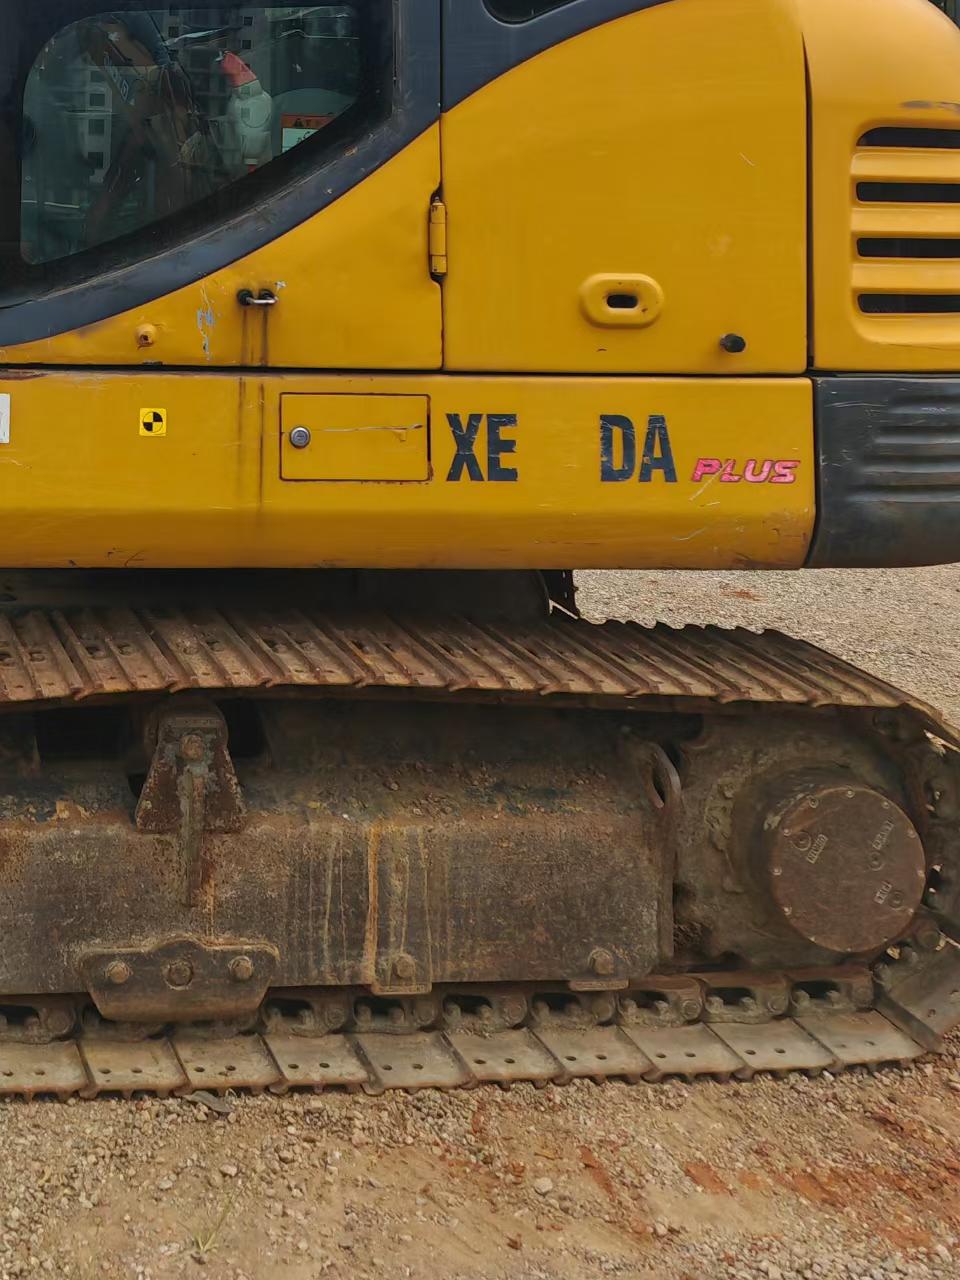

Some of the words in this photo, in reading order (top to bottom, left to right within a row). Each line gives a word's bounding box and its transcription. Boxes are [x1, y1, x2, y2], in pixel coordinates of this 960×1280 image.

[445, 413, 519, 482] XE
[600, 414, 678, 483] DA
[691, 458, 801, 484] PLUS
